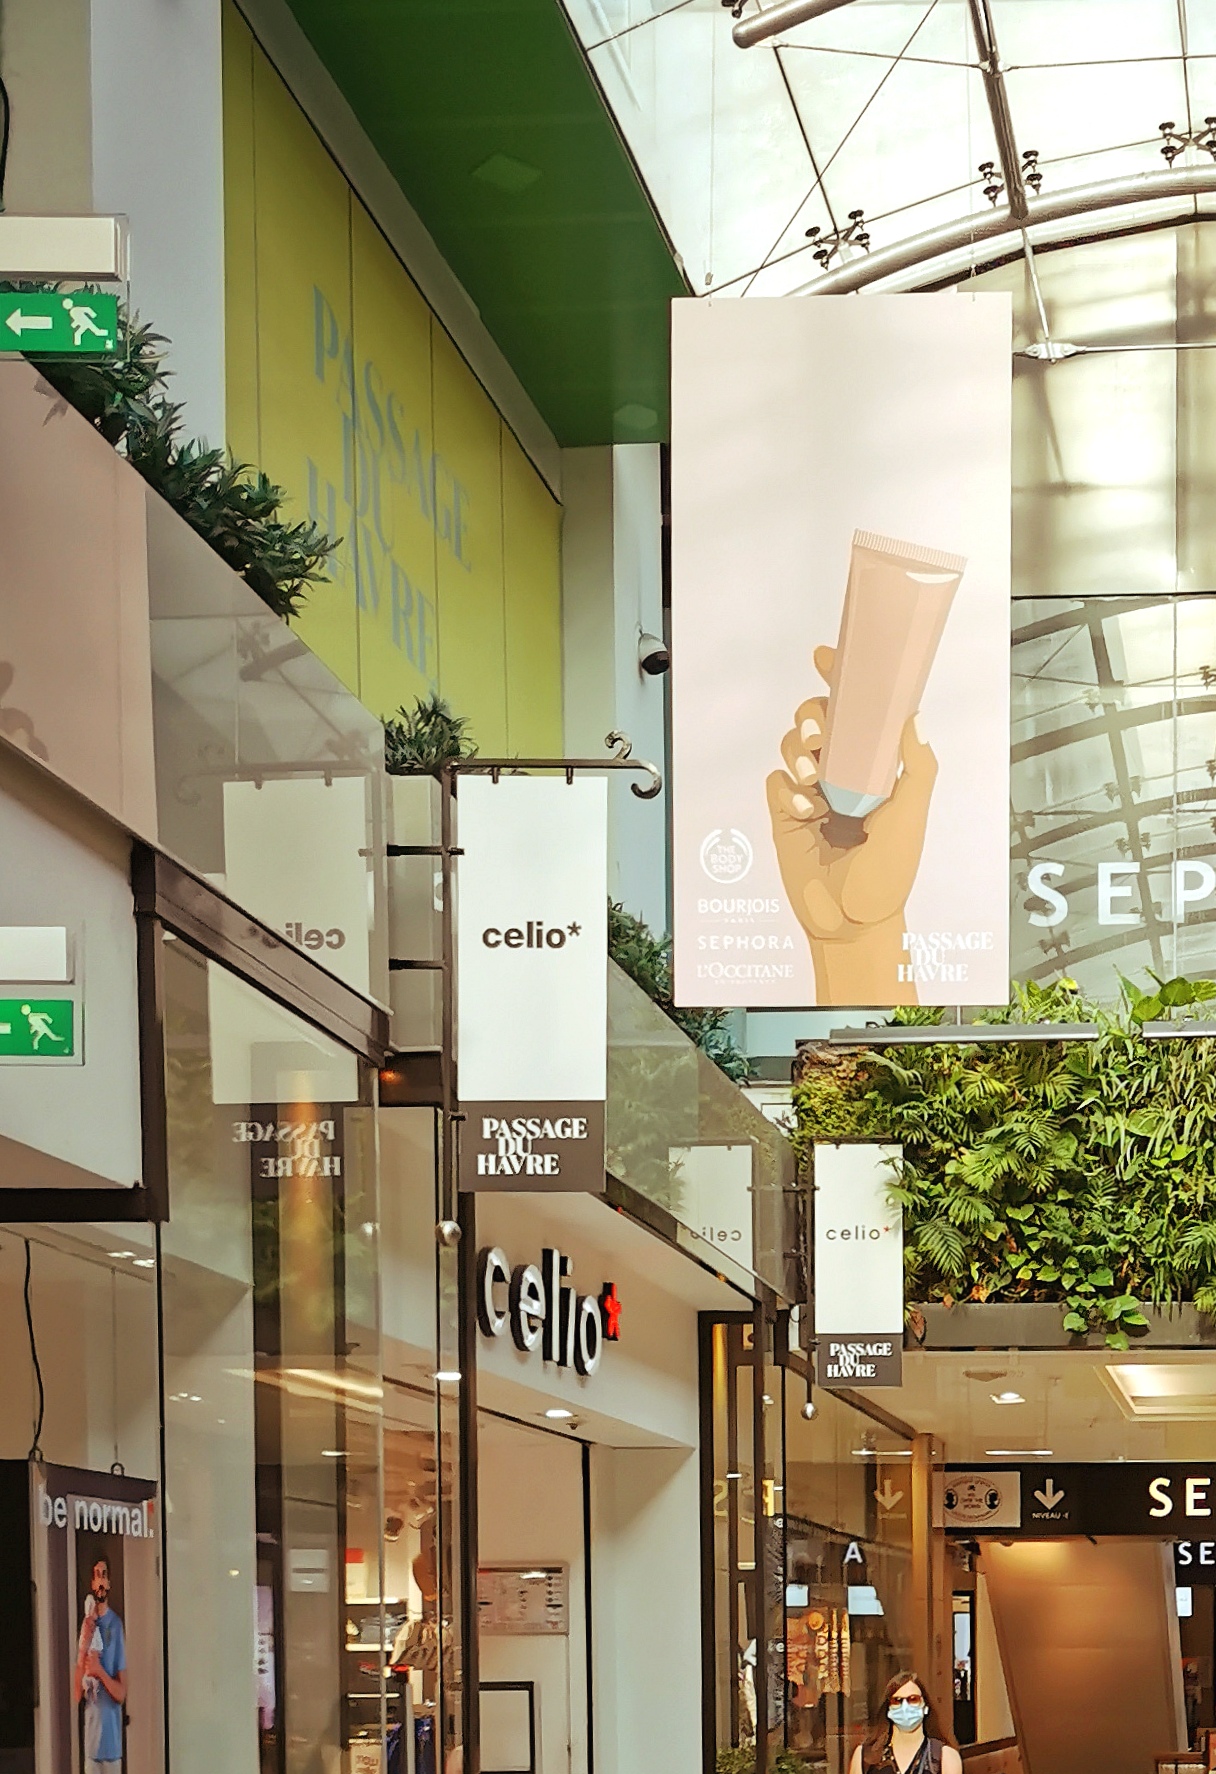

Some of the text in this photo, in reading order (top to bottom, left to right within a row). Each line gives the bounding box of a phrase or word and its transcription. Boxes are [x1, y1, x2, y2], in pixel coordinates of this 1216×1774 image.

[716, 844, 736, 853] THE
[710, 854, 744, 864] BODY
[712, 864, 742, 874] SHOP
[697, 898, 780, 915] BOURJOIS
[697, 935, 794, 950] SEPHORA
[902, 931, 994, 951] PASSAGE
[915, 948, 946, 966] DU
[897, 963, 969, 982] HAVRE
[482, 1117, 588, 1140] PASSAGE
[496, 1137, 533, 1157] DU
[476, 1154, 560, 1176] HAVRE
[829, 1342, 893, 1357] PASSAGE
[838, 1353, 861, 1367] DU
[826, 1364, 877, 1379] HAVRE
[39, 1484, 67, 1528] be
[1031, 1512, 1061, 1520] NIVEAU
